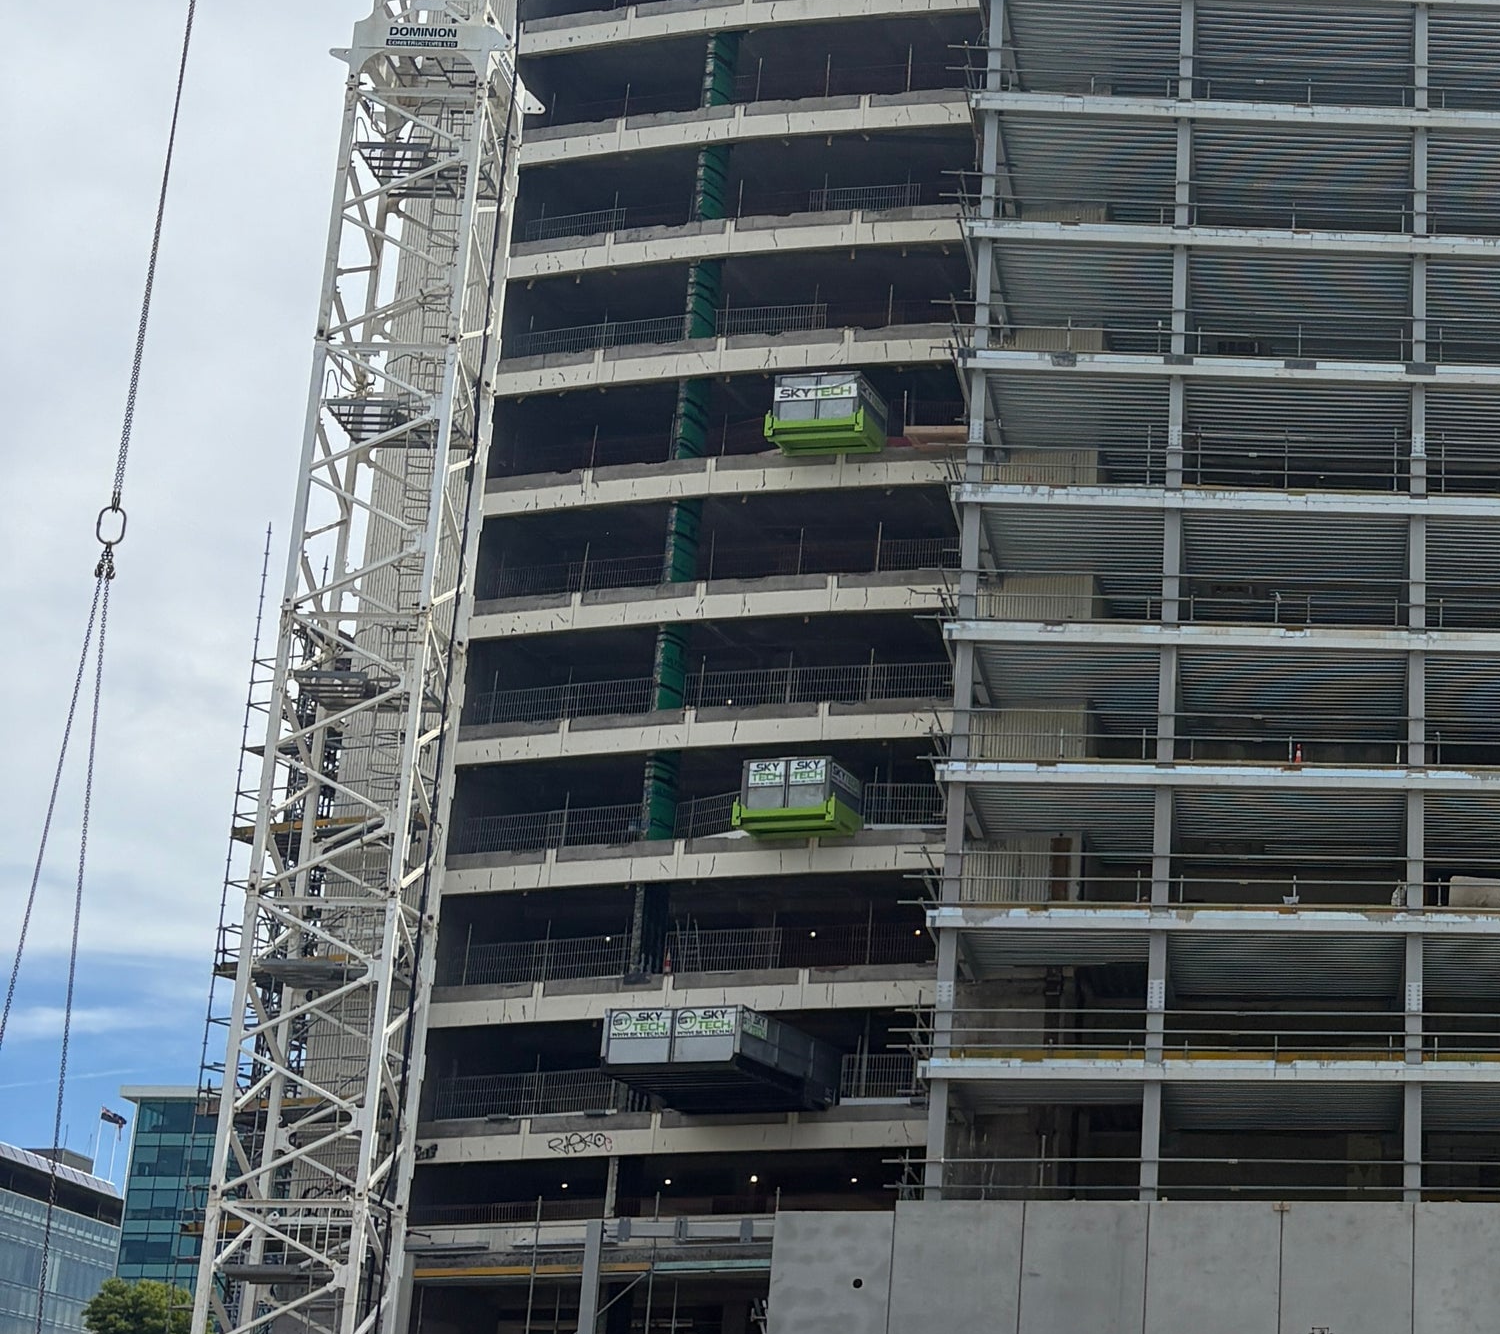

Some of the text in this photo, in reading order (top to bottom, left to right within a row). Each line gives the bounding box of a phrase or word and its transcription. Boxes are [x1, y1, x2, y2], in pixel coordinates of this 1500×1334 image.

[389, 26, 457, 37] DOMINION
[779, 386, 851, 399] SKYTECH
[753, 762, 780, 772] SKY
[794, 760, 821, 770] SKY
[752, 772, 782, 782] TECH
[793, 770, 823, 780] TECH
[636, 1012, 663, 1021] SKY
[701, 1010, 728, 1020] SKY
[633, 1021, 666, 1032] TECH
[698, 1019, 731, 1030] TECH
